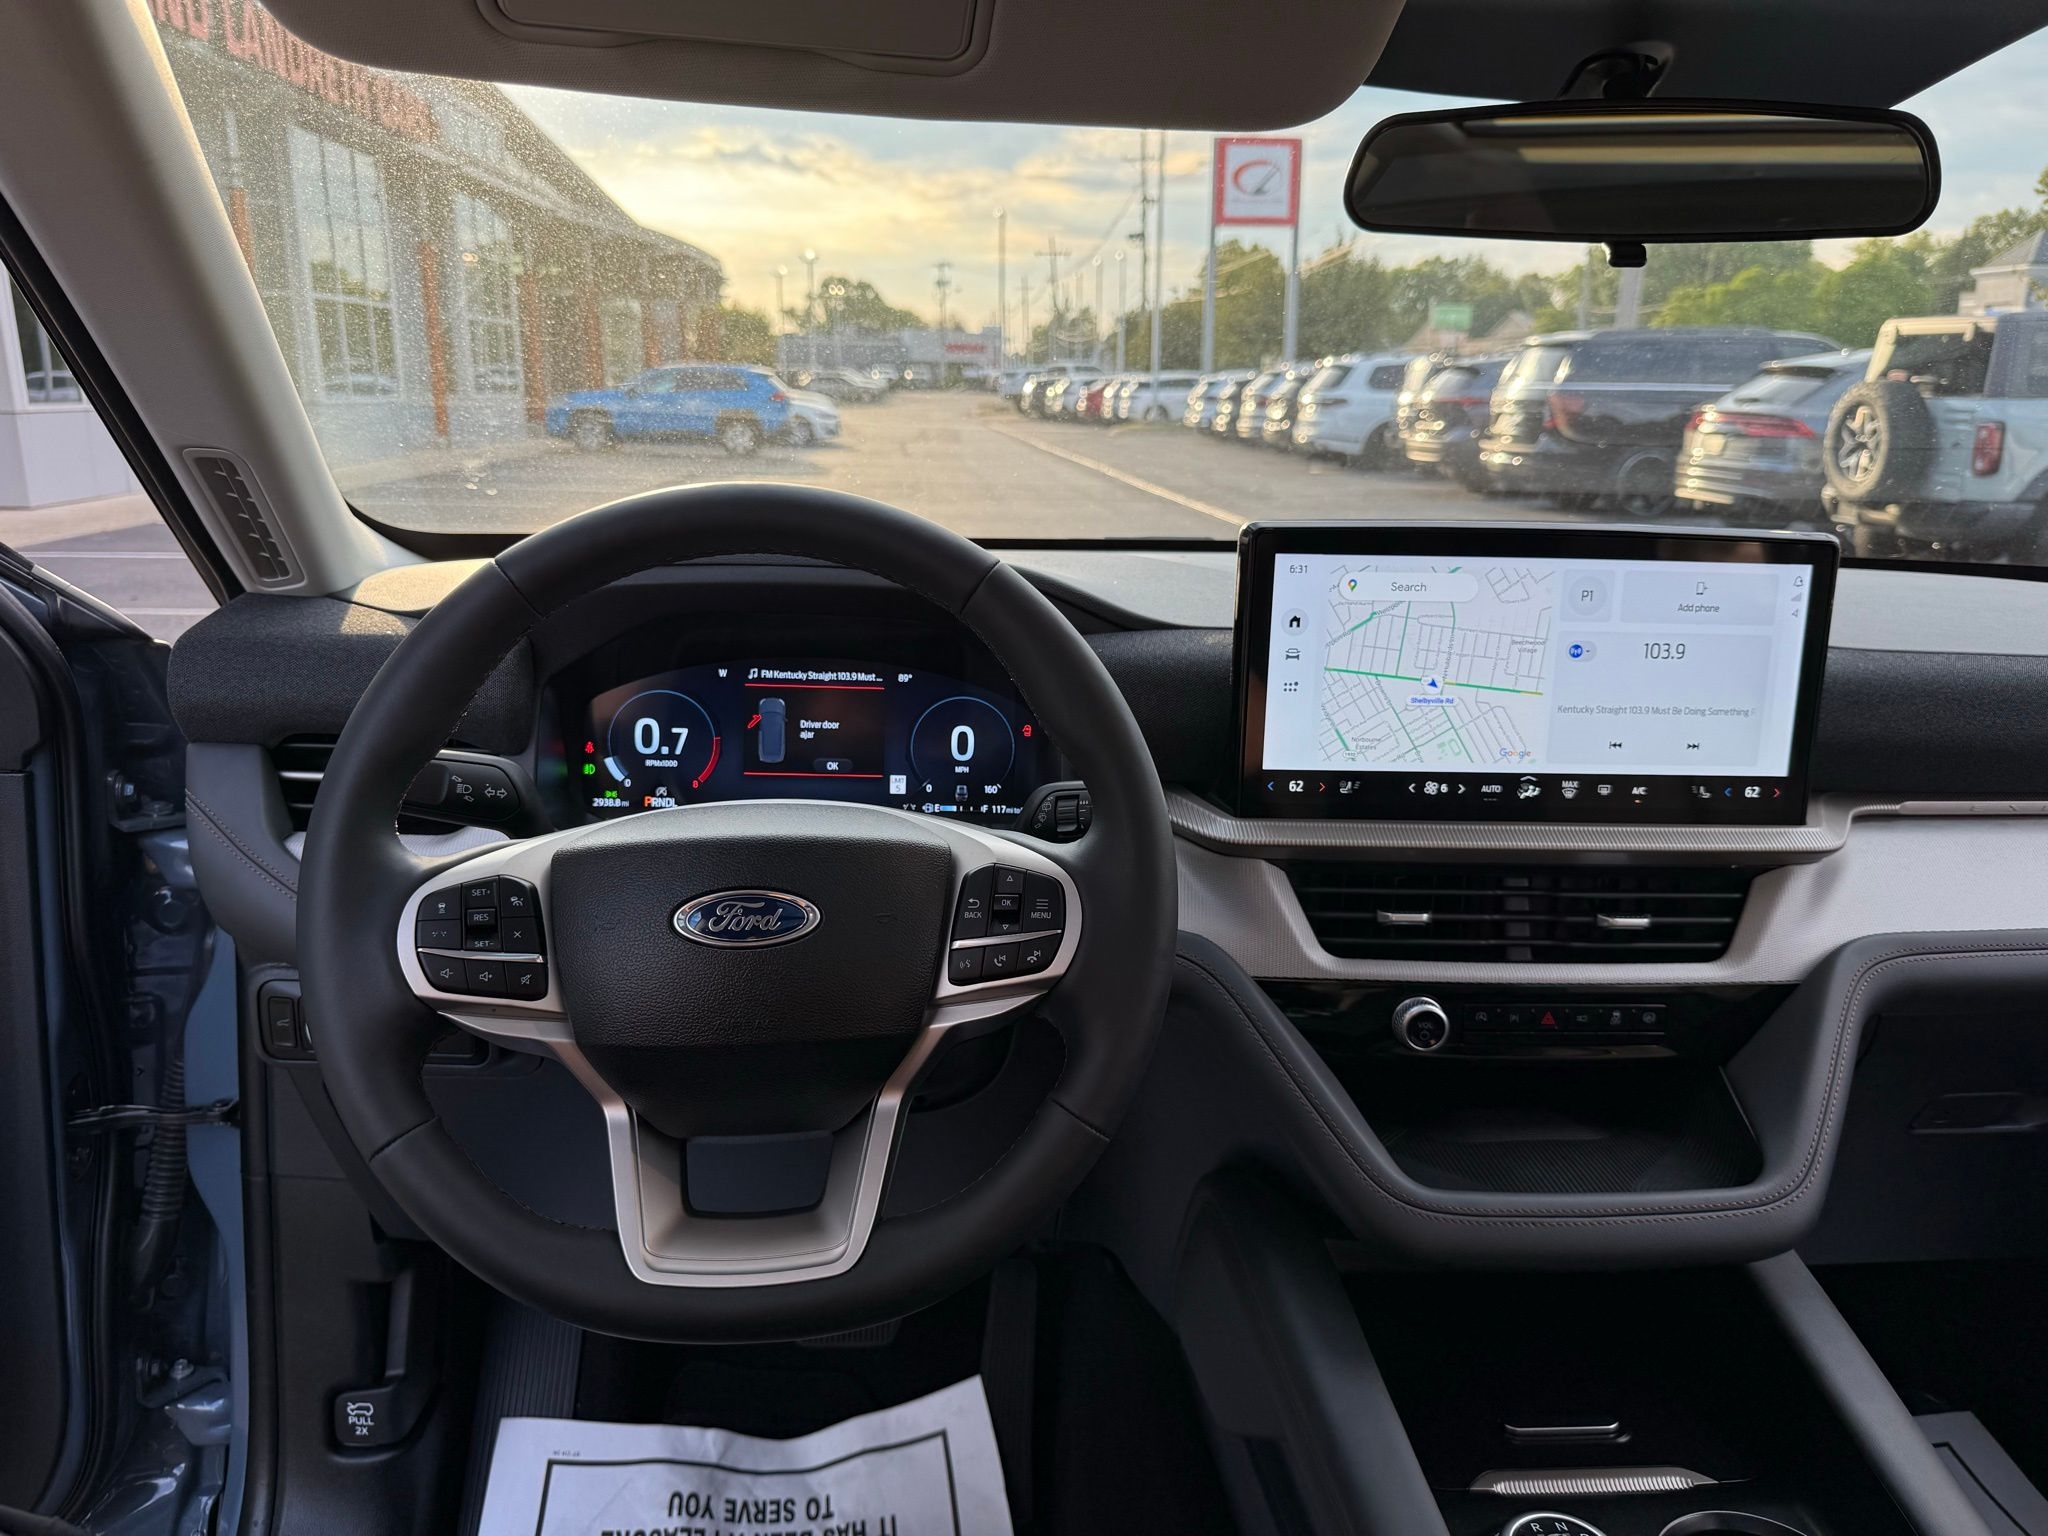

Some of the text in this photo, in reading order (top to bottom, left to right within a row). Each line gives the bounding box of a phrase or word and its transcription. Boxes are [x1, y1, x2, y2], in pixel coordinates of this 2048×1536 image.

[1289, 565, 1308, 574] 6:31
[1390, 582, 1427, 592] Search
[1581, 590, 1593, 602] P1
[1677, 604, 1720, 614] Add phone
[1644, 643, 1686, 659] 103.9
[718, 669, 728, 677] W
[761, 670, 773, 679] FM
[774, 670, 807, 681] Kentucky
[808, 671, 837, 682] Straight
[838, 672, 857, 681] 103.9
[1410, 697, 1454, 705] Shelbyville Rd
[1557, 705, 1594, 715] Kentucky
[1596, 705, 1628, 715] Straight
[1629, 706, 1650, 715] 103.9
[1651, 706, 1670, 715] Must
[1672, 706, 1682, 715] Be
[1684, 707, 1705, 717] Doing
[1707, 707, 1750, 717] Something
[800, 720, 840, 729] Driver door
[634, 718, 689, 755] 0.7
[800, 730, 814, 740] ajar
[951, 725, 975, 761] 0
[1500, 747, 1532, 760] Google
[826, 762, 839, 770] OK
[955, 765, 969, 774] MPH
[624, 778, 632, 787] 0
[692, 780, 699, 788] 8
[1289, 780, 1304, 792] 62
[1440, 783, 1448, 792] 6
[1562, 780, 1579, 788] MAX
[926, 783, 933, 793] 0
[984, 785, 998, 794] 160
[1481, 784, 1501, 793] AUTO
[1632, 786, 1648, 795] A/C
[1744, 786, 1760, 798] 62
[592, 798, 621, 807] 2938.8
[935, 804, 940, 812] E
[992, 805, 1006, 814] 117
[708, 901, 782, 932] Ford
[348, 1416, 374, 1425] PULL
[355, 1426, 369, 1436] 2X
[668, 1490, 834, 1524] TO SERVE YOU
[1531, 1522, 1543, 1533] R
[1554, 1521, 1569, 1532] N
